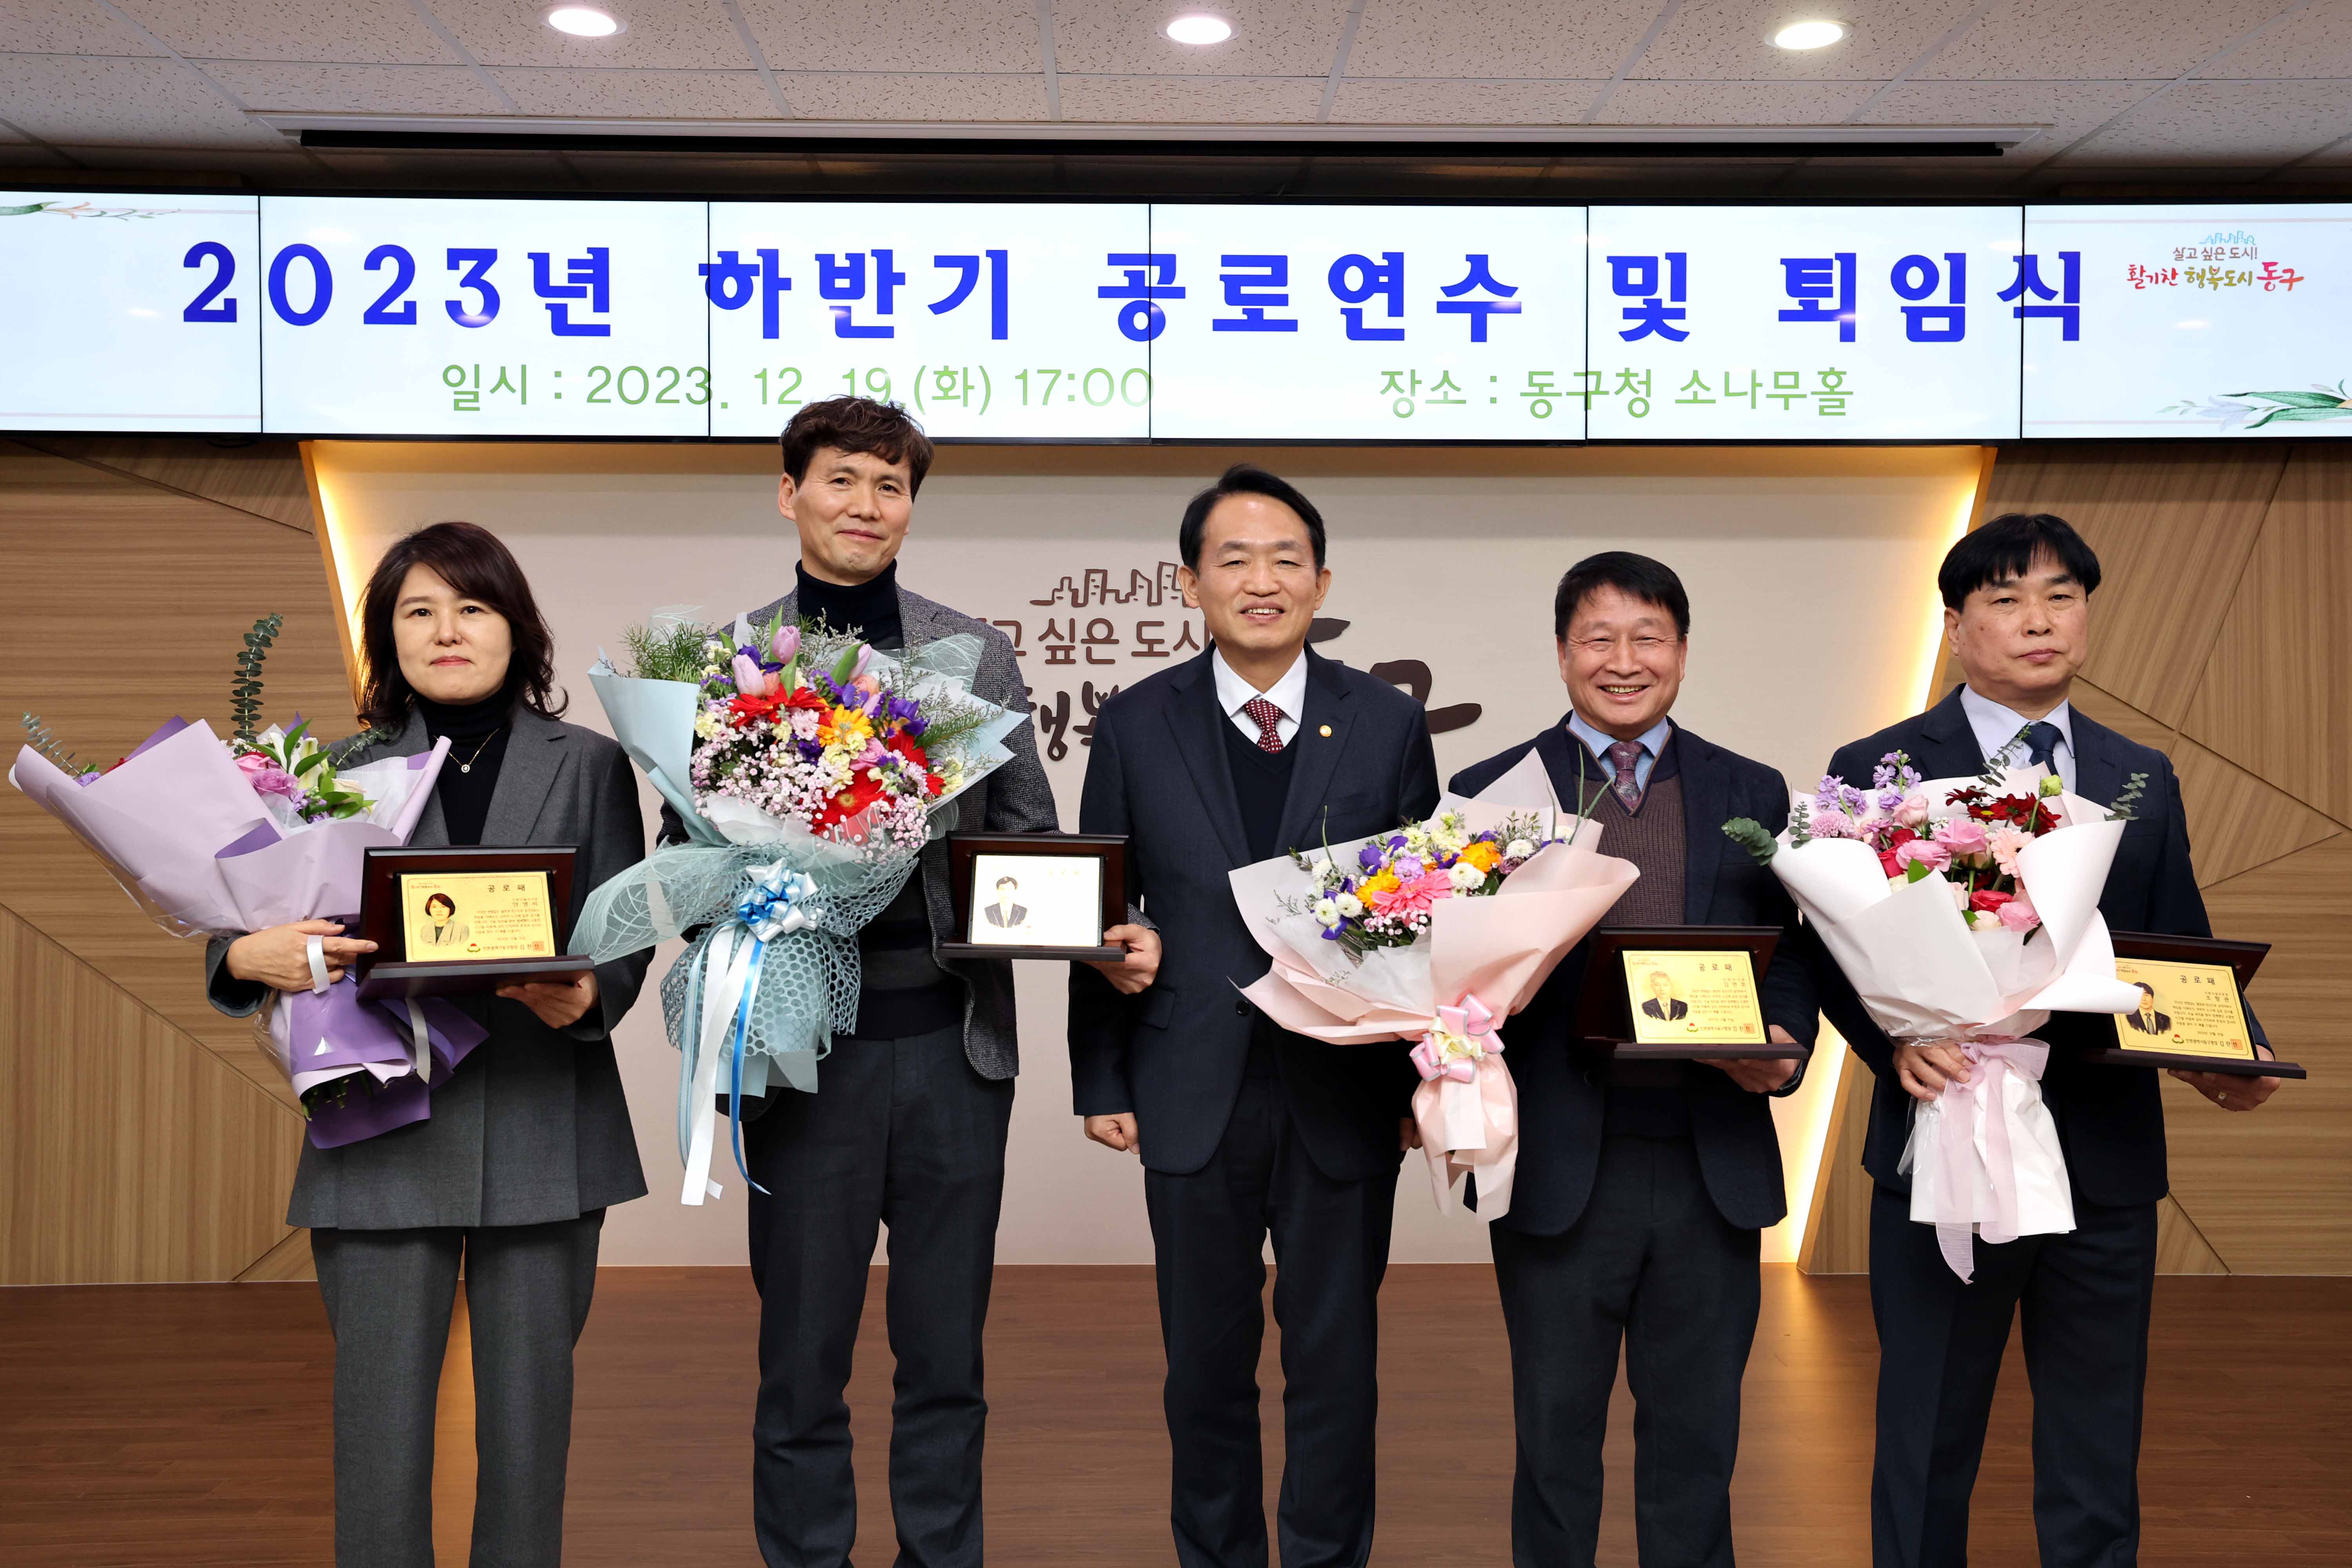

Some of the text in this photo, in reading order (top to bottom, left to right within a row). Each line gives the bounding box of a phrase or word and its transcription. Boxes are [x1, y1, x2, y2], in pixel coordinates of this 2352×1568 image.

[2126, 261, 2305, 291] 활기찬 행복도시 동구
[2173, 247, 2258, 261] 살고 싶은 도시!
[183, 241, 2081, 343] 2023년 하반기 공로연수 및 퇴임식
[443, 364, 527, 411] 일시
[586, 365, 728, 410] 2023.
[1015, 367, 1154, 407] 17:00
[1380, 369, 1466, 418] 장소
[1520, 367, 1652, 419] 동구청
[1675, 367, 1854, 416] 소나무홀
[1038, 618, 1120, 664] 싶은
